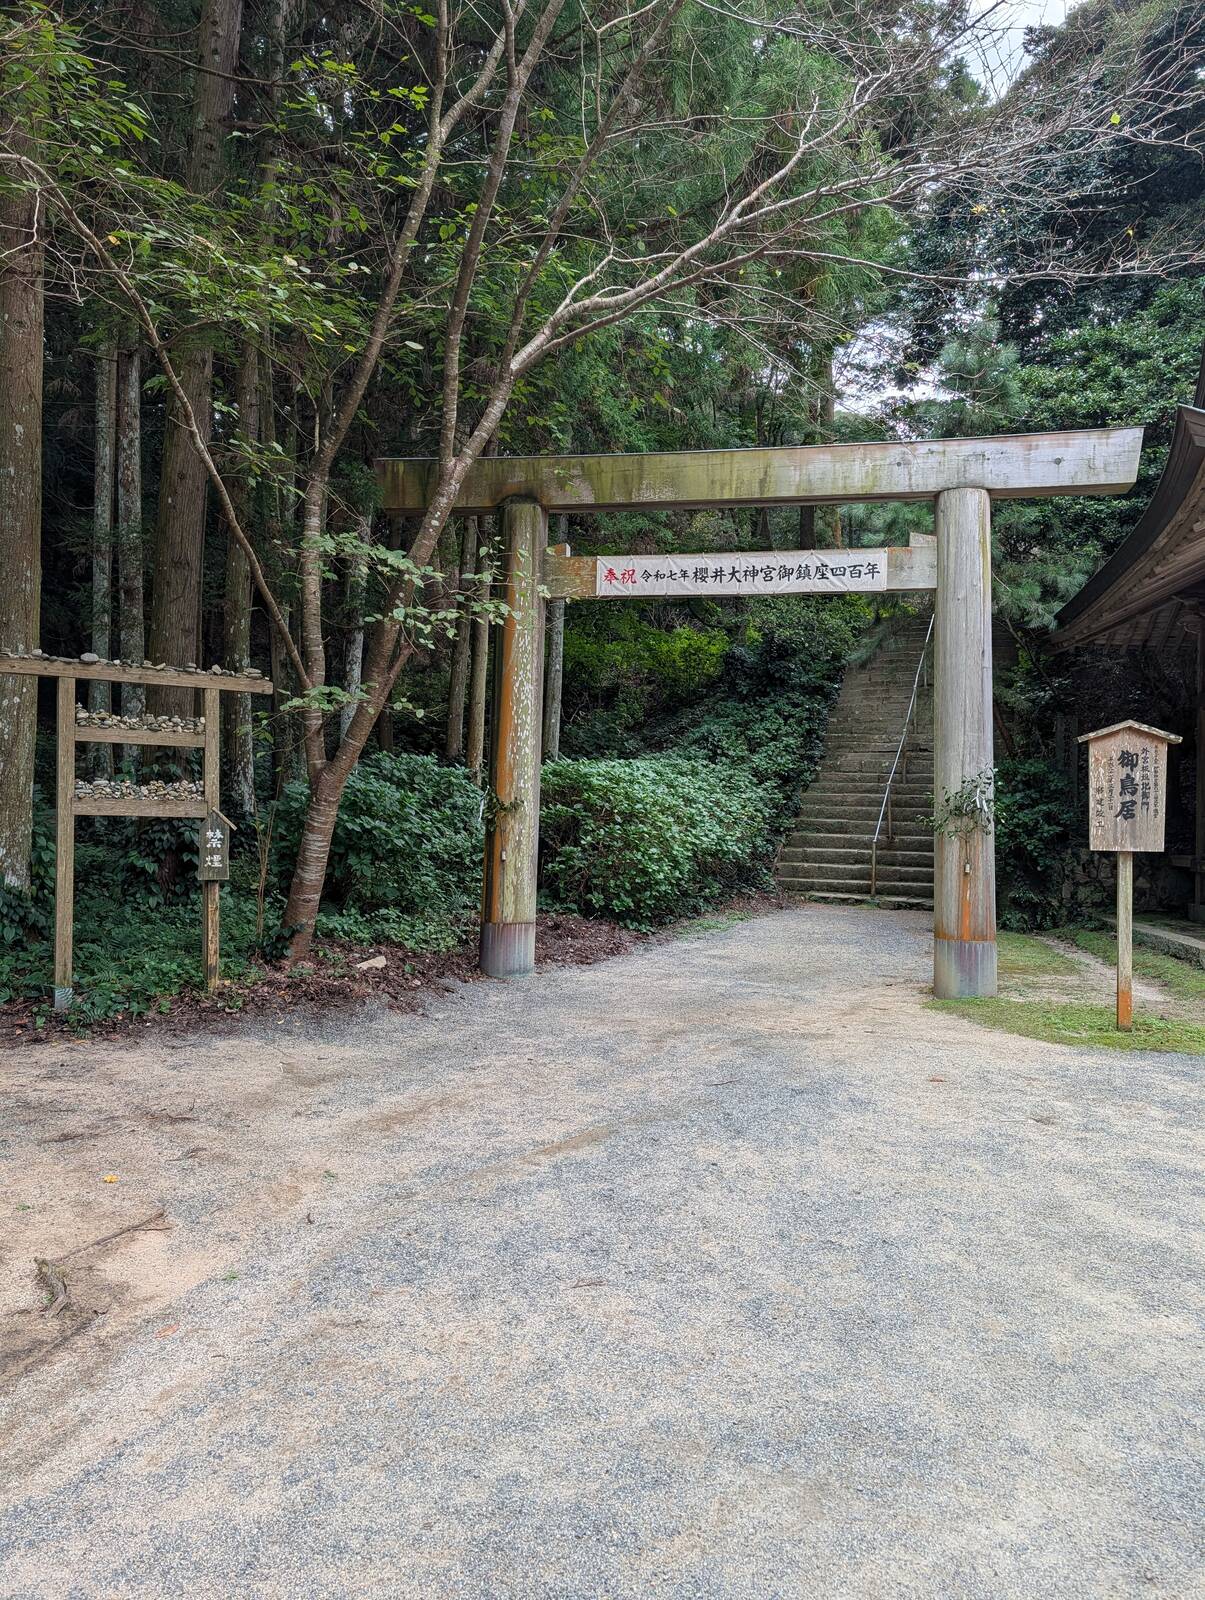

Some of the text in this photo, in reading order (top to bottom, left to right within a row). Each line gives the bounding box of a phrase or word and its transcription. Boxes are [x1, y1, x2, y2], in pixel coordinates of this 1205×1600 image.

[1114, 750, 1140, 821] 御鳥居
[204, 828, 224, 867] 禁煙
